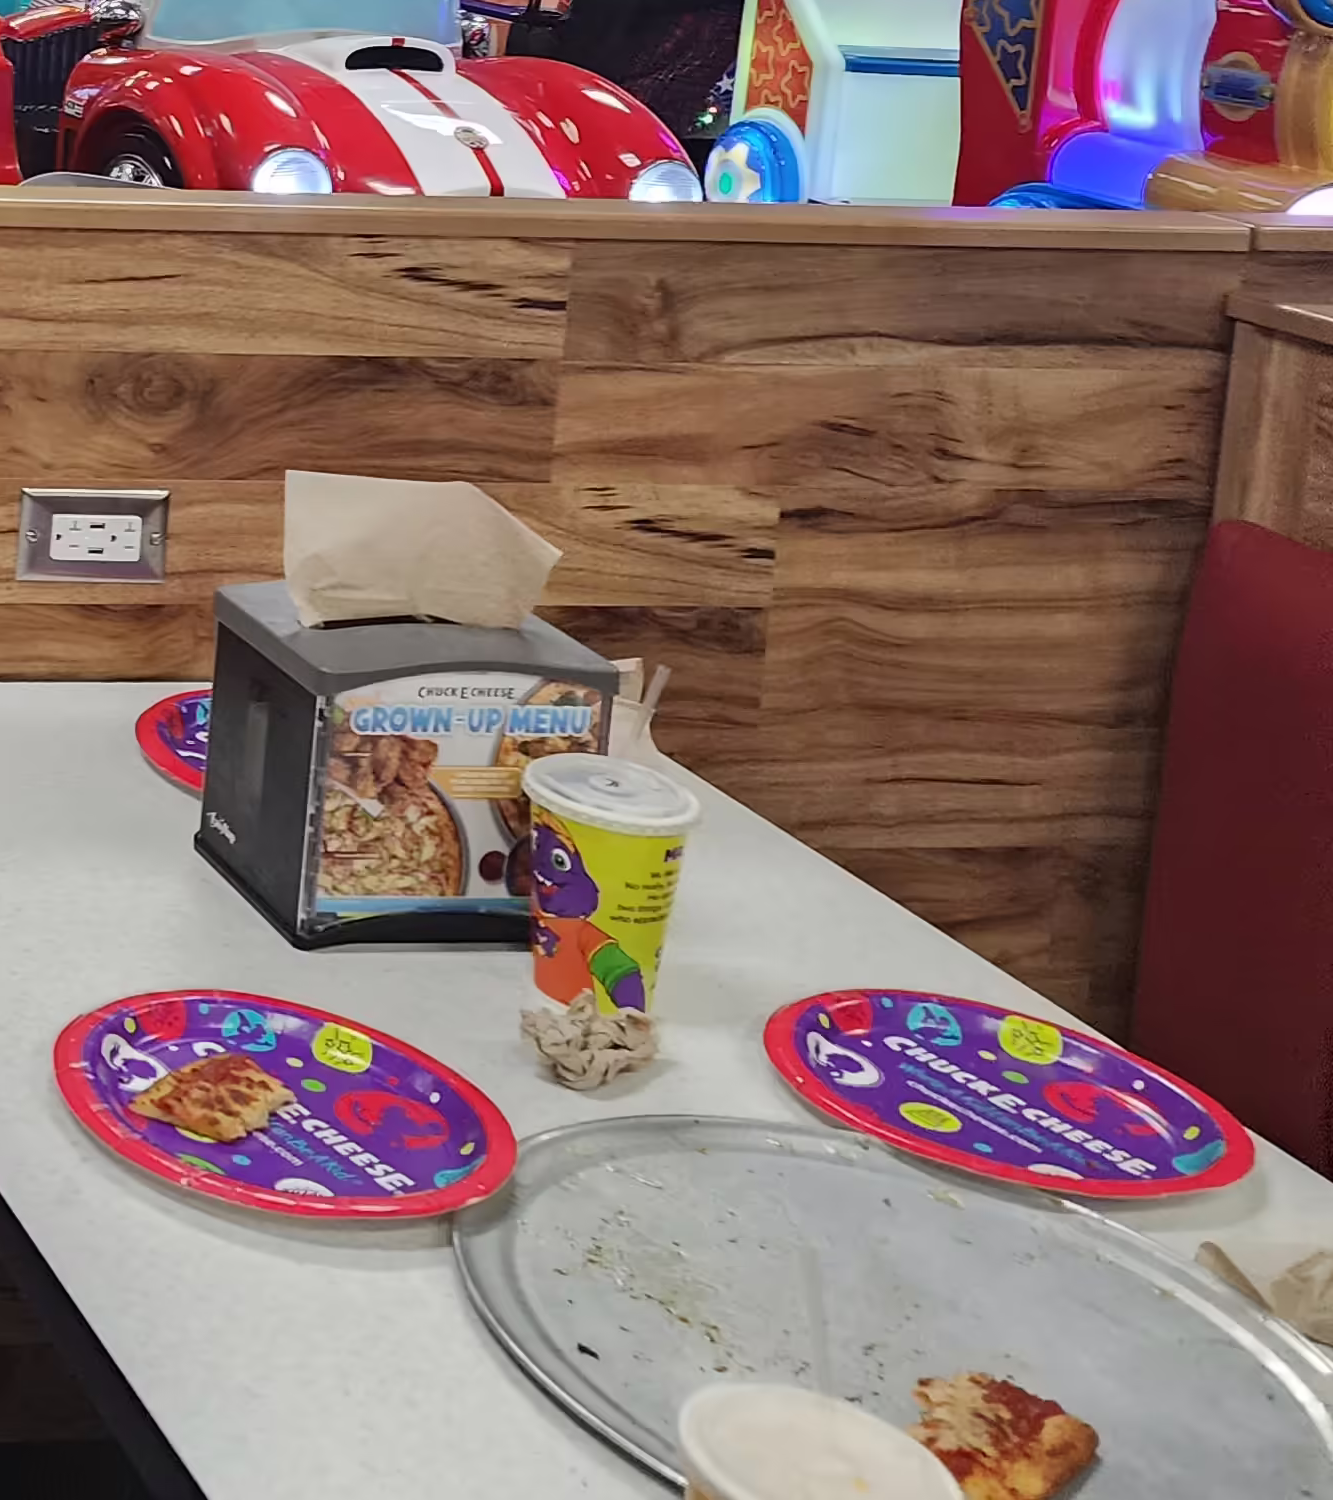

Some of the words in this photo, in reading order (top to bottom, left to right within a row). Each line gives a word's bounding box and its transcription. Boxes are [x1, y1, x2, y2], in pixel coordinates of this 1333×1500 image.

[417, 686, 460, 698] CHUCK
[470, 687, 515, 699] CHEESE
[352, 705, 503, 734] GROWN-UP
[508, 706, 591, 734] MENU
[882, 1035, 1002, 1097] CHUCK
